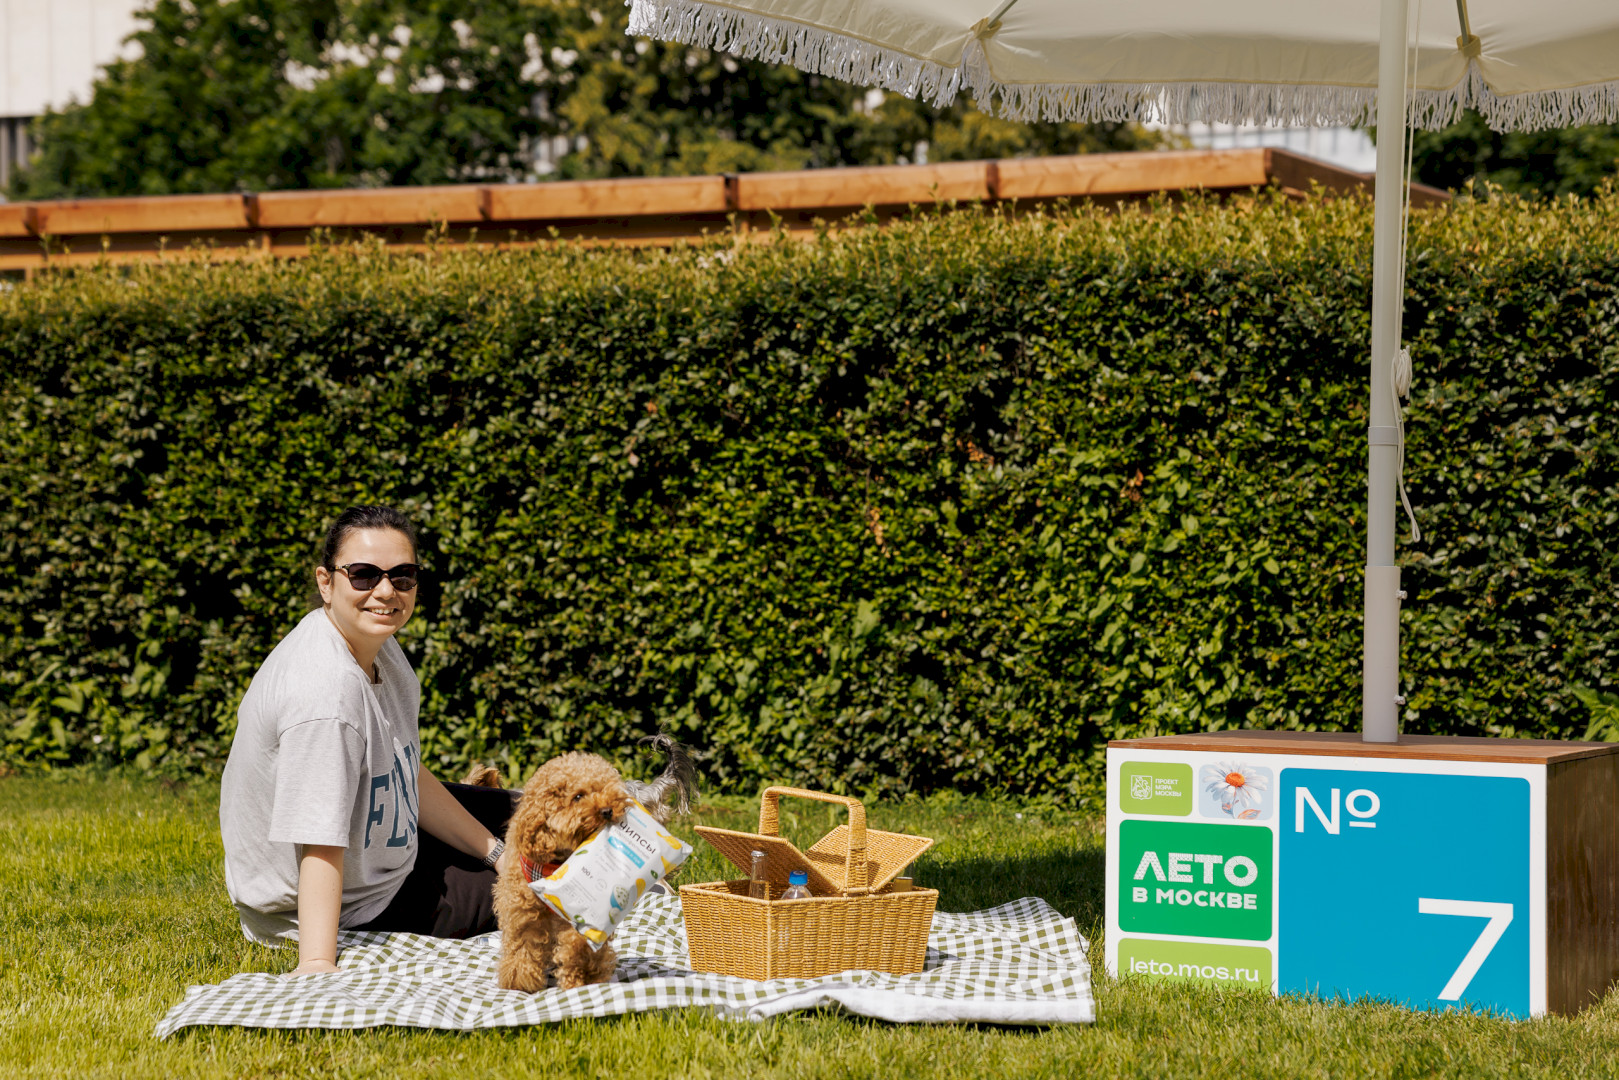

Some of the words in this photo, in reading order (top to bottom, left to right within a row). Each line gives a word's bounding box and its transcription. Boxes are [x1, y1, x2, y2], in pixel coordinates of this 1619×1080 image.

[1133, 851, 1259, 887] ЛЕТО
[1132, 887, 1148, 903] В
[1156, 888, 1258, 910] МОСКВЕ
[1418, 897, 1514, 1001] 7
[1130, 957, 1259, 982] leto.mos.ru
